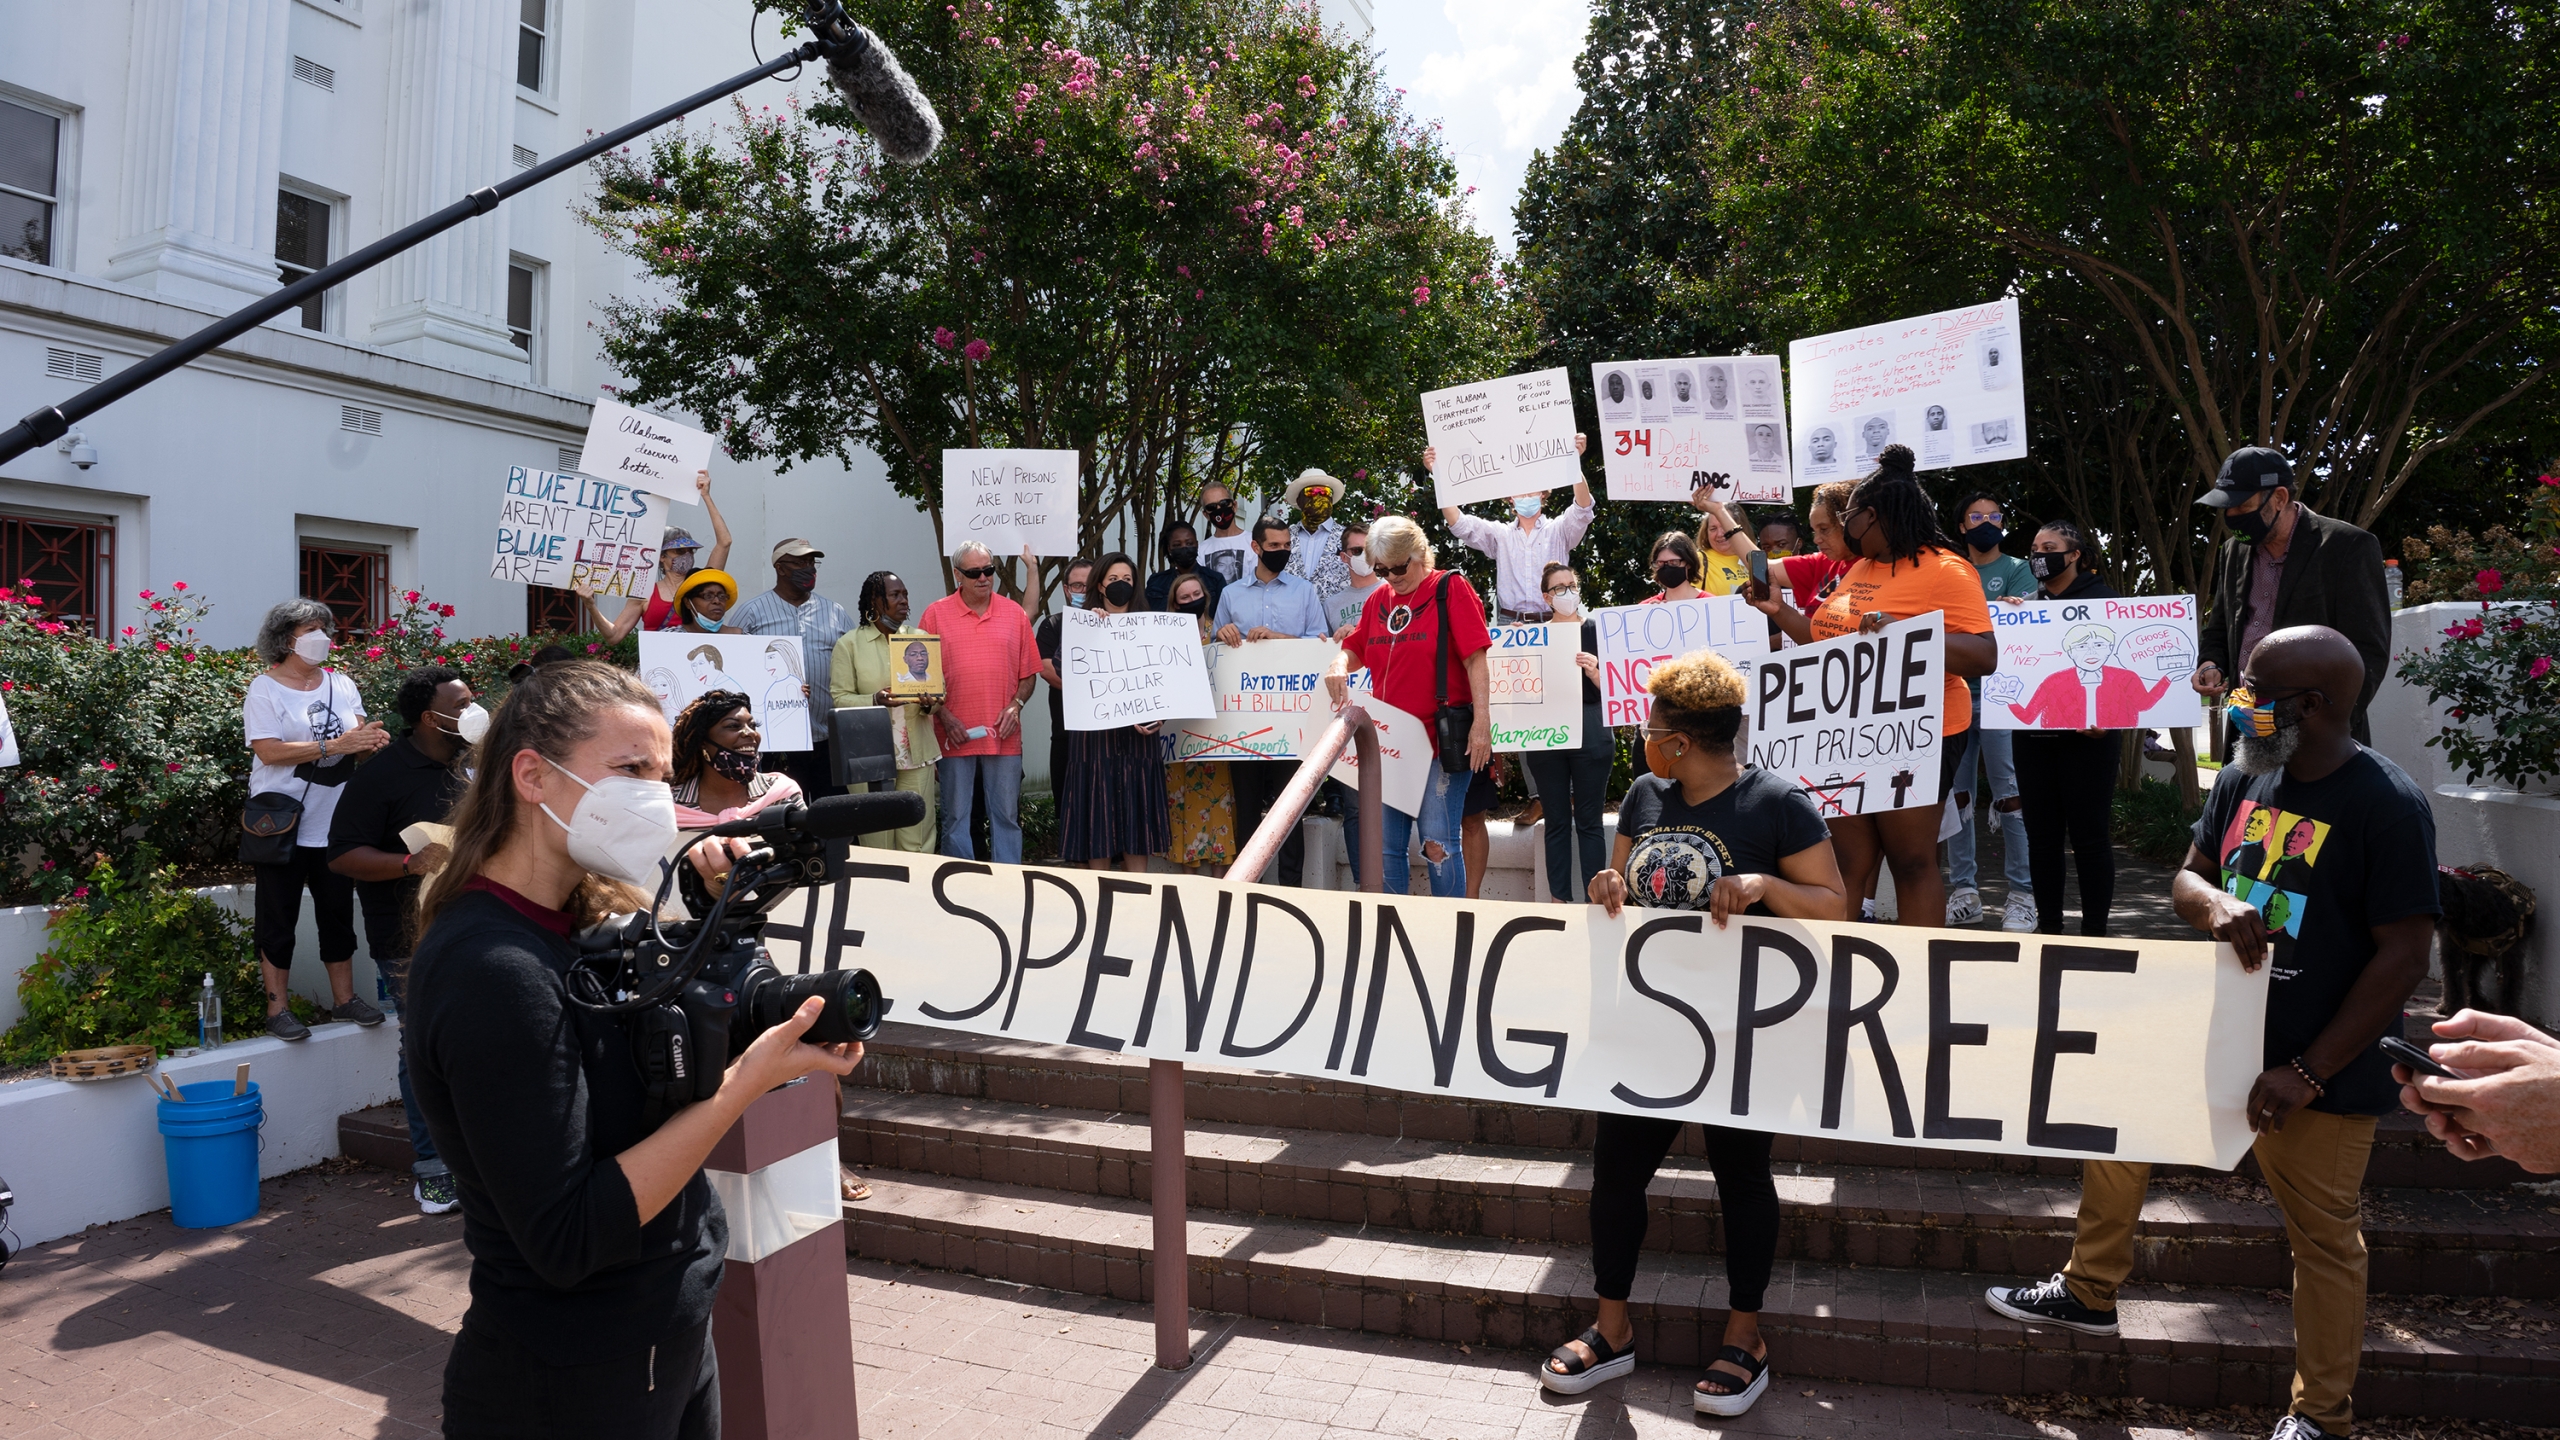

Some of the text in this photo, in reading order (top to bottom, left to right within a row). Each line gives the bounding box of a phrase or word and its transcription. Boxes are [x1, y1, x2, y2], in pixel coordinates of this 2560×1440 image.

[1802, 304, 2004, 363] Inmates are DYING
[1835, 340, 1965, 376] inside our correctional
[1830, 364, 1956, 400] protection? Where is the
[1833, 353, 1964, 392] facilities. Where is their
[1517, 379, 1552, 391] THIS USE
[1517, 390, 1551, 402] OF COVID
[1828, 394, 1865, 413] State?
[1912, 377, 1941, 391] Prisons
[1435, 392, 1487, 410] THE ALABAMA
[1518, 401, 1551, 413] RELIEF
[1433, 403, 1492, 423] DEPARTMENT OF
[1442, 415, 1486, 432] CORRECTIONS
[618, 415, 674, 446] Alabama
[635, 444, 682, 464] deserves
[1615, 428, 1710, 457] 34 Deaths
[619, 457, 664, 480] better.
[1448, 453, 1501, 483] CRUEL
[1509, 438, 1574, 465] UNUSUAL
[1644, 455, 1698, 471] in 2021
[972, 467, 1005, 486] NEW
[1624, 473, 1654, 493] Hold
[1664, 473, 1682, 490] the
[1690, 471, 1731, 491] ADOC
[506, 465, 651, 518] BLUE LIVES
[976, 492, 1043, 507] ARE NOT
[501, 500, 643, 545] AREN'T REAL
[969, 512, 1048, 531] COVID RELIEF
[497, 528, 656, 570] BLUE LIES
[491, 556, 648, 600] ARE REAL
[1070, 612, 1187, 628] ALABAMA CAN'T AFFORD
[1826, 613, 1845, 622] THEY
[1987, 596, 2193, 626] PEOPLE OR PRISONS?
[1111, 630, 1136, 641] THIS
[1501, 626, 1549, 648] 2021
[1601, 599, 1757, 654] PEOPLE
[2003, 643, 2033, 656] KAY
[2126, 630, 2170, 649] I CHOOSE
[1071, 644, 1192, 675] BILLION
[2014, 655, 2042, 667] IVEY
[1089, 672, 1164, 699] DOLLAR
[1240, 672, 1260, 691] PAY
[1261, 675, 1275, 691] TO
[1276, 674, 1300, 692] THE
[1758, 628, 1933, 731] PEOPLE
[767, 699, 808, 711] ALABAMIANS
[1094, 695, 1170, 720] GAMBLE.
[1223, 694, 1312, 712] 1.4 BILLIO
[1231, 730, 1290, 759] Supports
[1753, 715, 1935, 771] NOT PRISONS
[589, 812, 608, 826] KN95
[1676, 825, 1703, 833] LUCY
[1704, 830, 1734, 868] BETSEY
[918, 861, 1568, 1098] SPENDING
[1610, 915, 2139, 1155] SPREE
[671, 1033, 685, 1078] Canon
